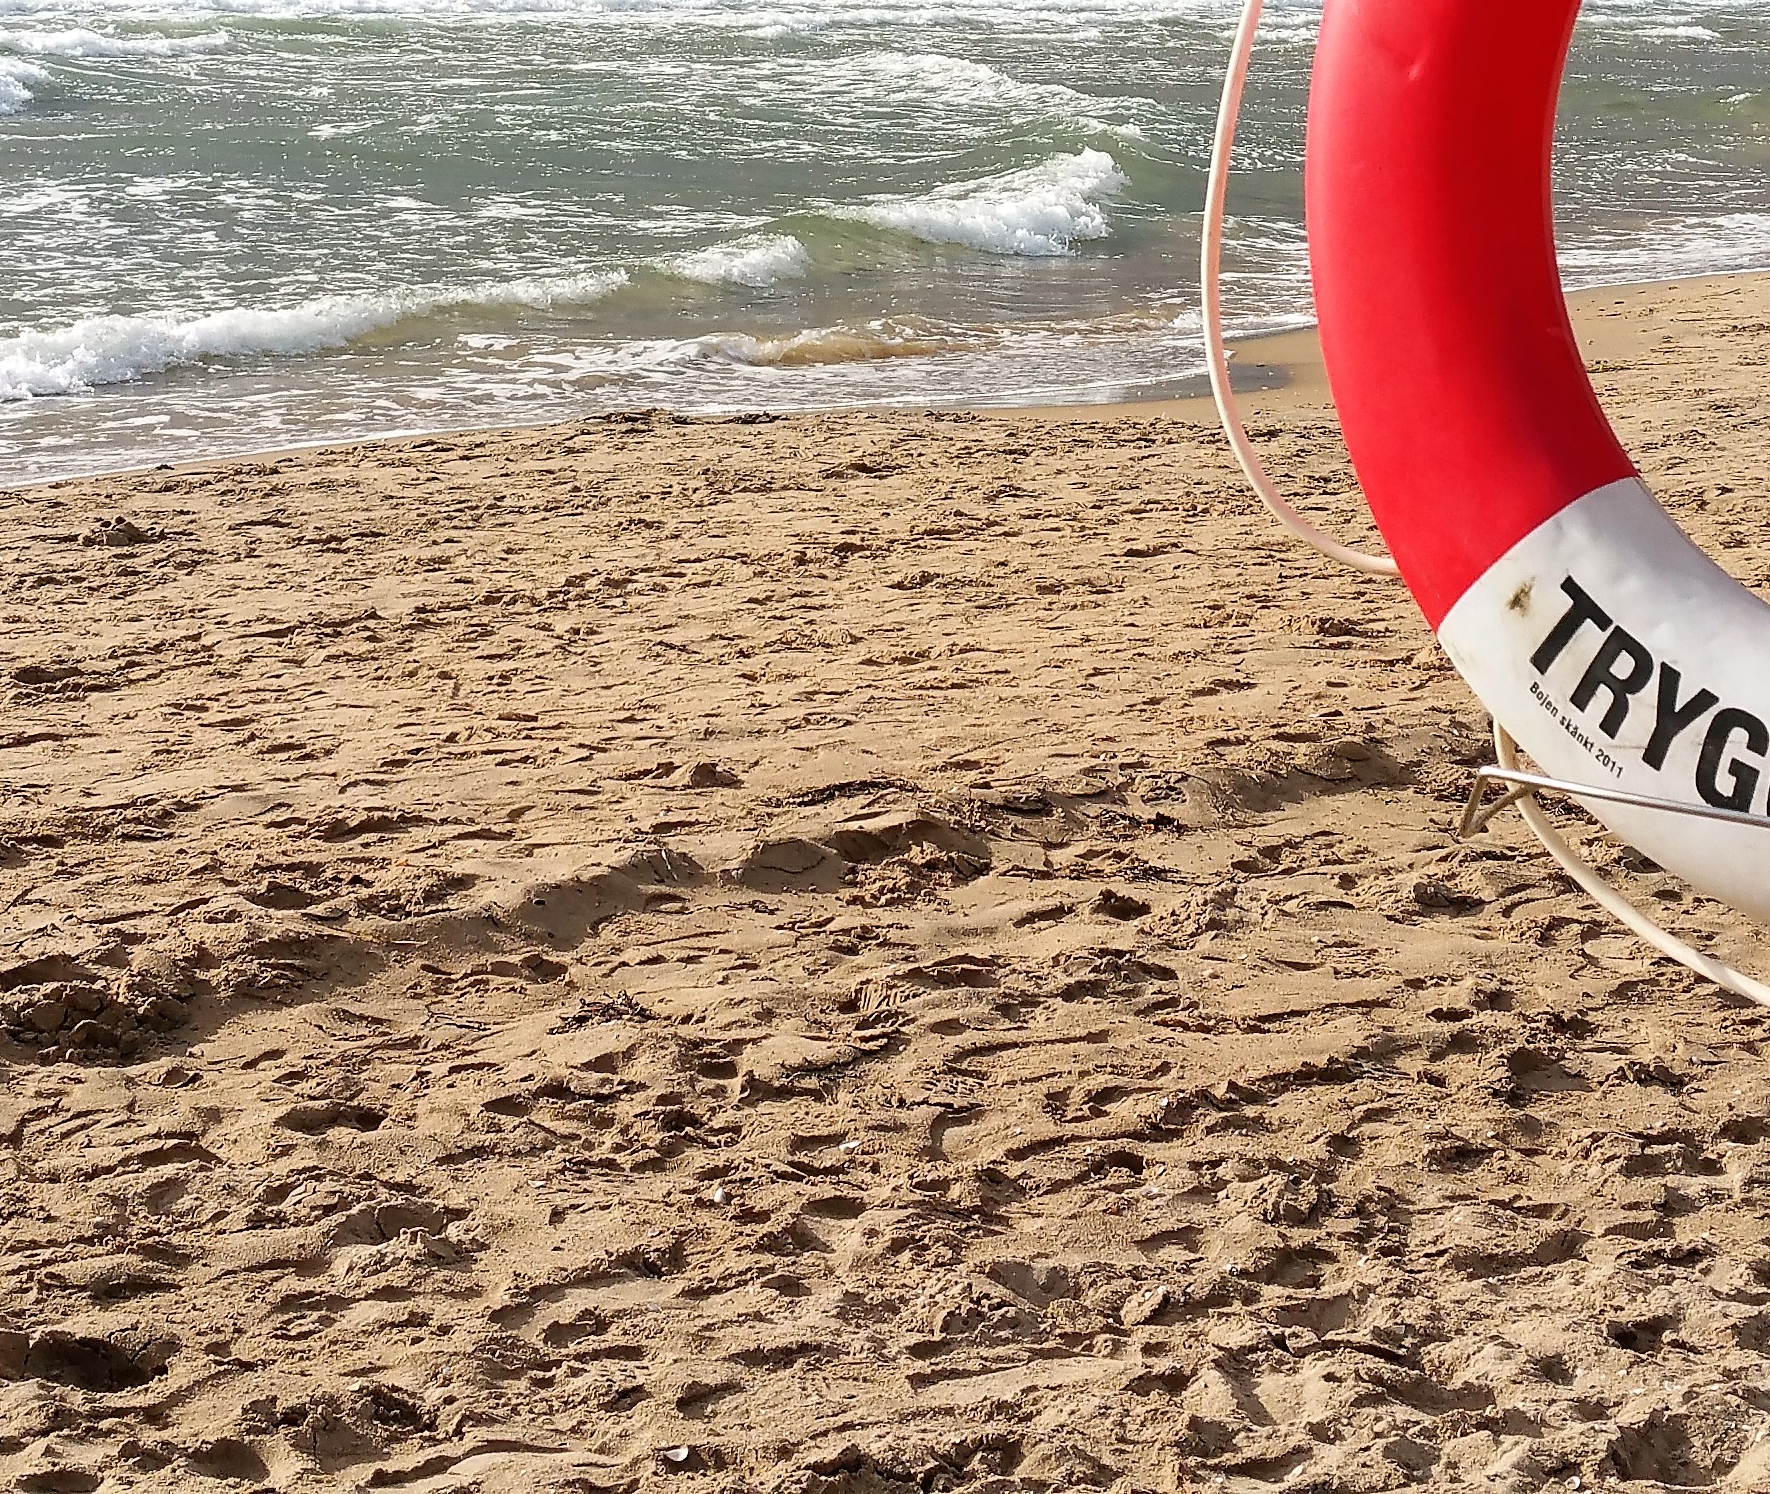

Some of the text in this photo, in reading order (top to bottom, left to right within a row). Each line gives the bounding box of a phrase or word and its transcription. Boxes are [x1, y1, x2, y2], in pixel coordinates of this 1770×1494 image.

[1530, 681, 1624, 779] Bojen skänkt 2011
